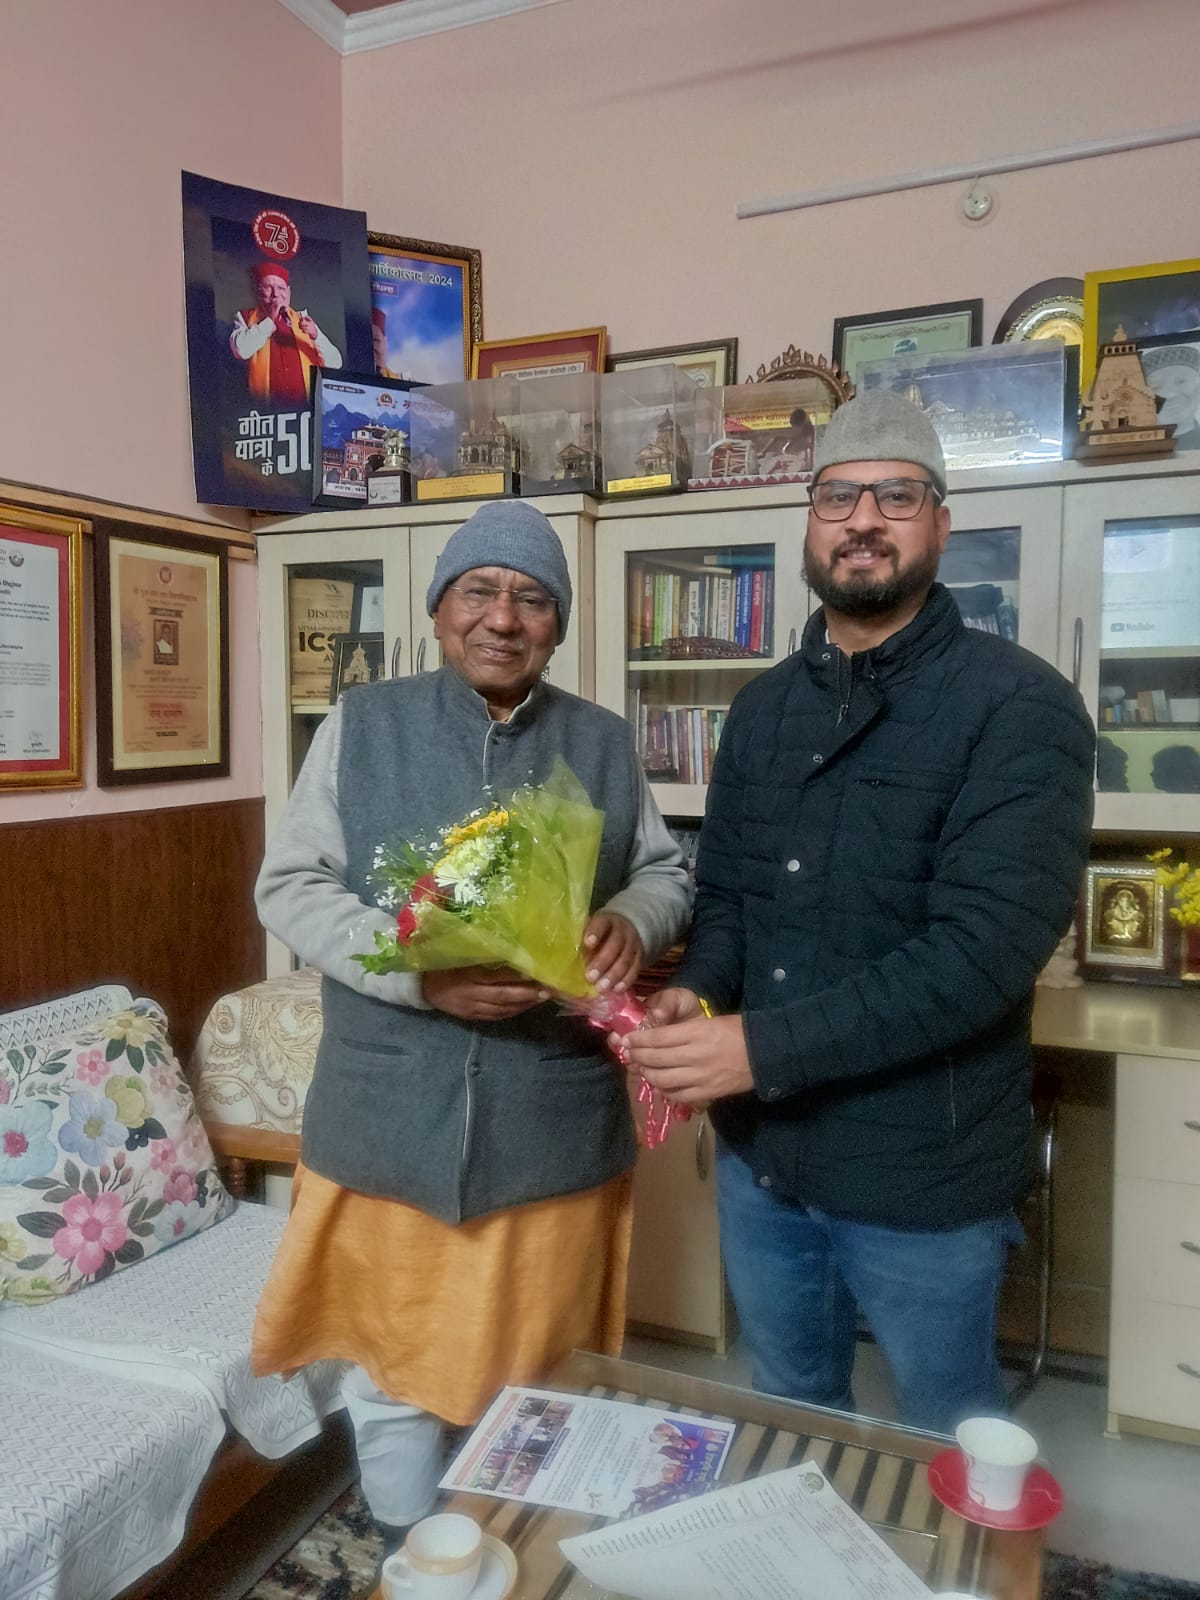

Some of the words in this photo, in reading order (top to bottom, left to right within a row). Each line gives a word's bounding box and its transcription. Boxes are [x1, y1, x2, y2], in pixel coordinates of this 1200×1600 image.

[264, 222, 289, 254] 75
[428, 273, 453, 288] 2024
[238, 410, 275, 437] गीत
[234, 437, 274, 460] यात्रा
[261, 458, 274, 477] के
